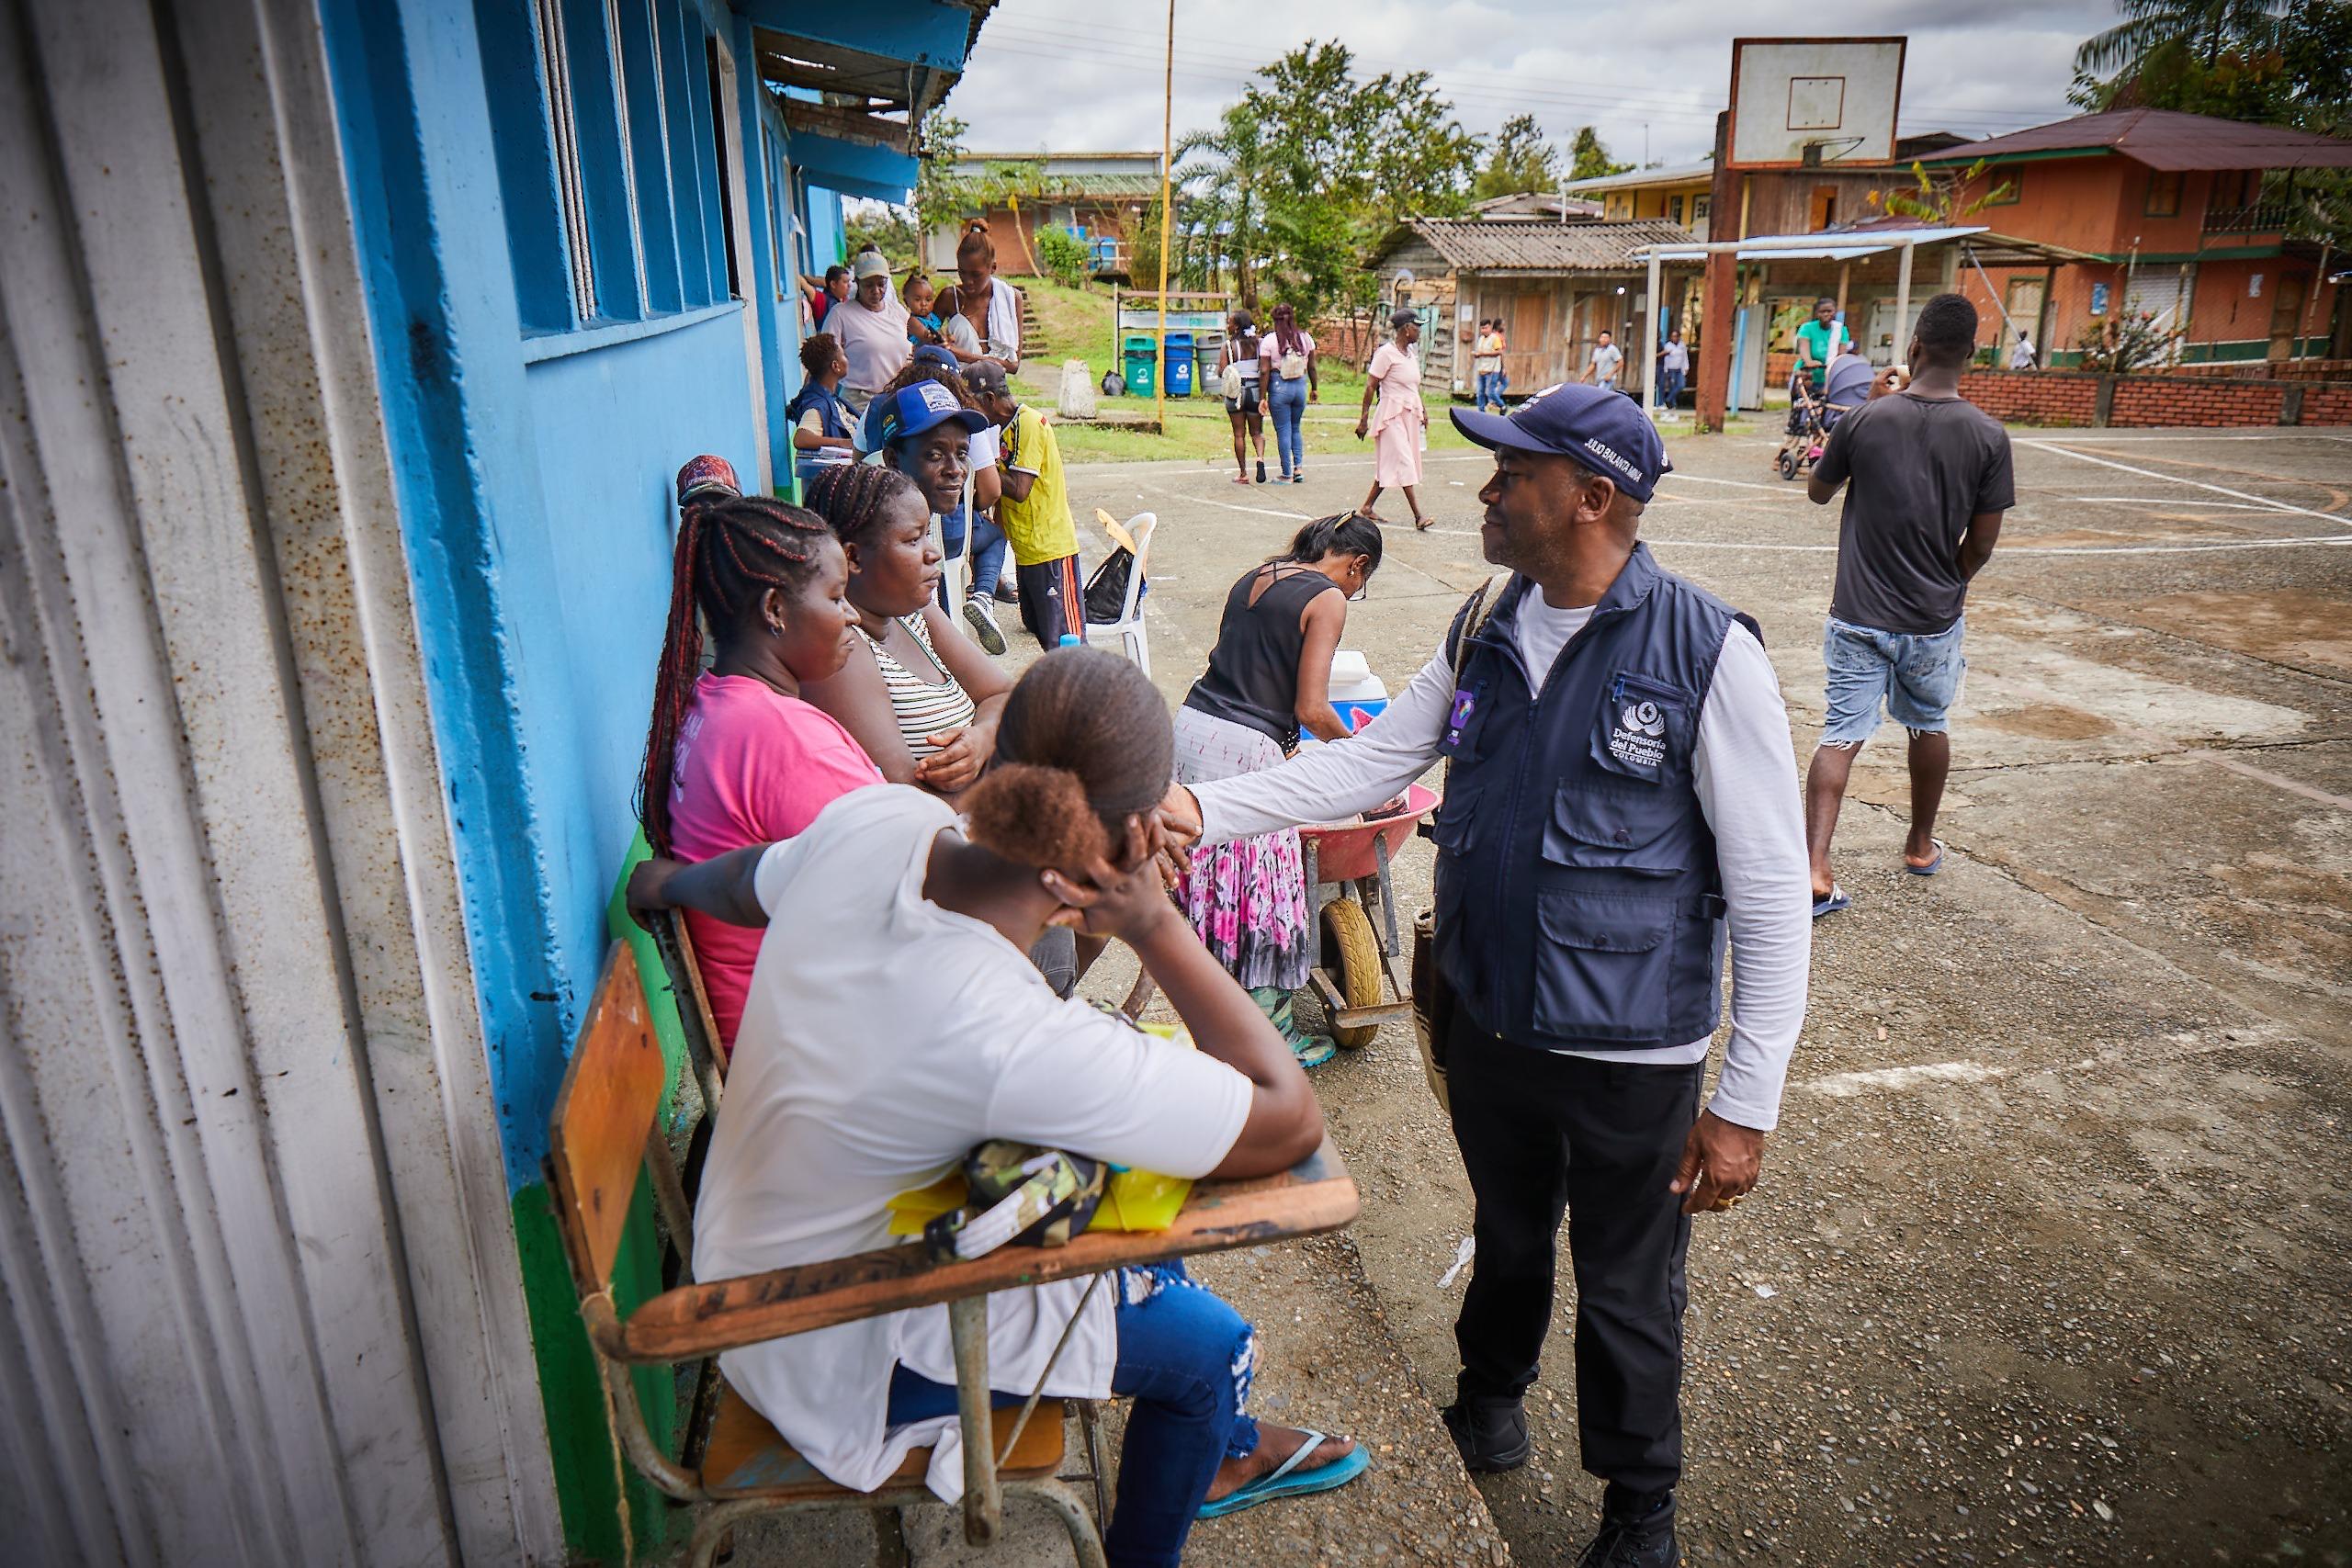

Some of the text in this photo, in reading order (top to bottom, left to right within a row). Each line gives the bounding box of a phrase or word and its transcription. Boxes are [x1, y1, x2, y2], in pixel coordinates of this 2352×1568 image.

[1584, 437, 1606, 455] JULIO
[1601, 447, 1631, 473] BALANTA
[1611, 739, 1664, 760] del Pueblo
[1612, 728, 1667, 750] Defensoría
[1612, 750, 1657, 767] COLOMBIA
